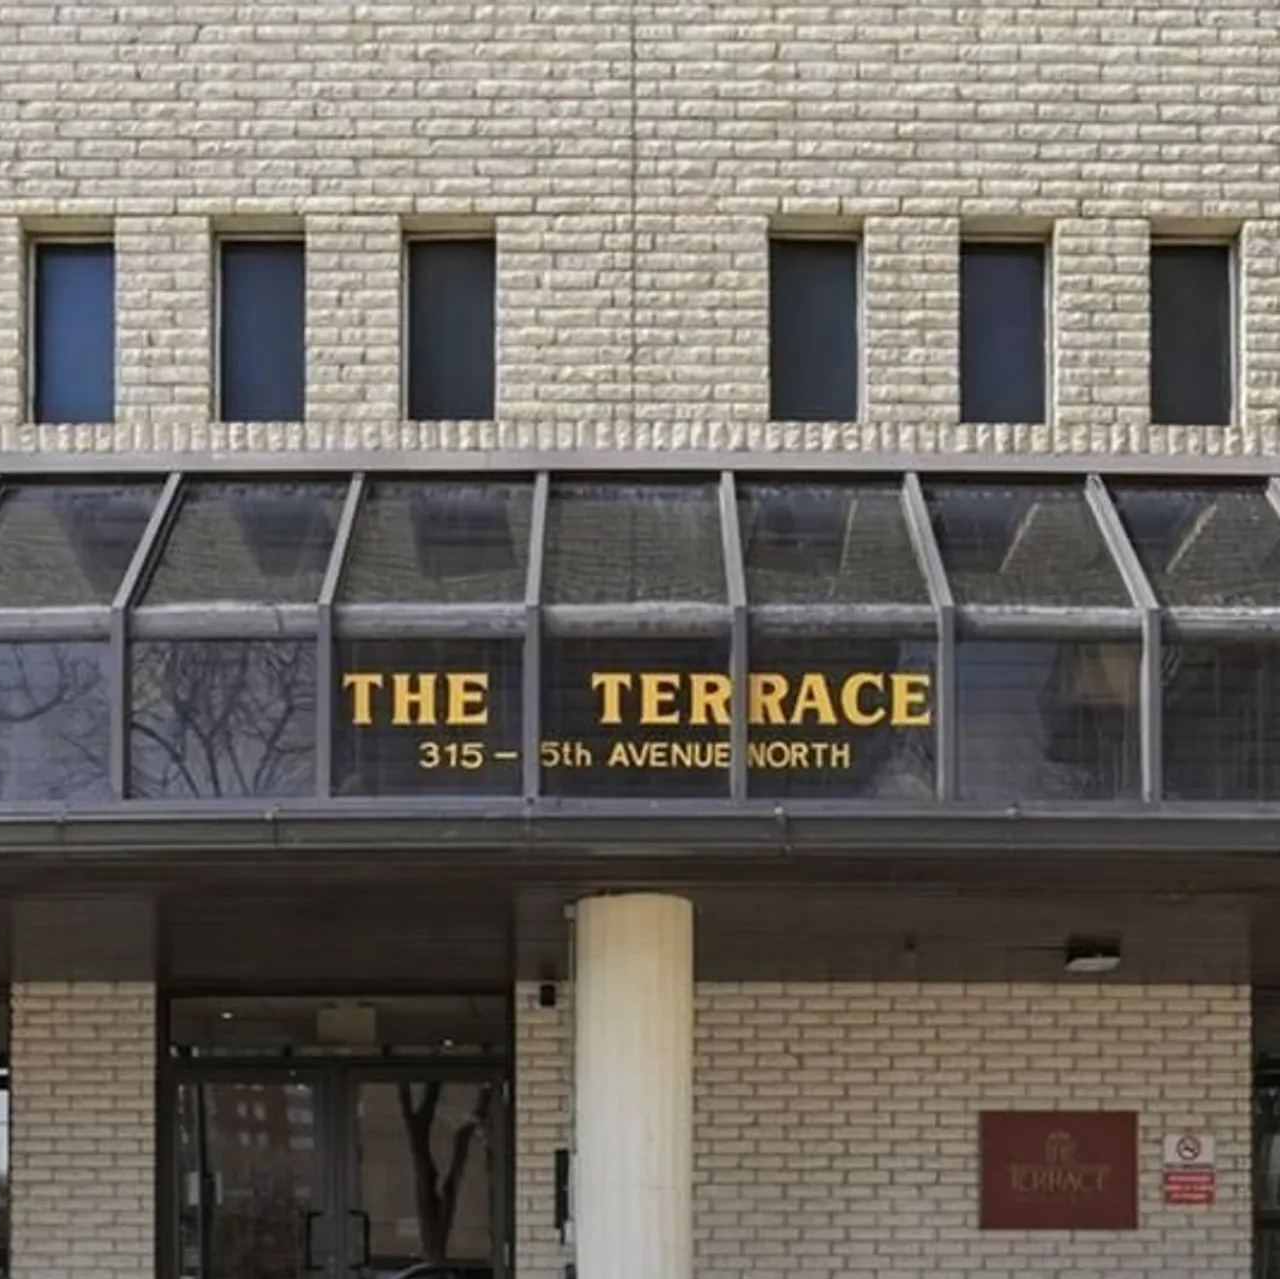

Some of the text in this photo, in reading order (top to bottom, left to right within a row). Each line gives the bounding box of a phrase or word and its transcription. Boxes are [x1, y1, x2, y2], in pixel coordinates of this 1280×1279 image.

[342, 672, 932, 726] THE TERRACE
[539, 741, 591, 768] 5th
[609, 741, 731, 768] AVENUE
[747, 741, 851, 768] NORTH
